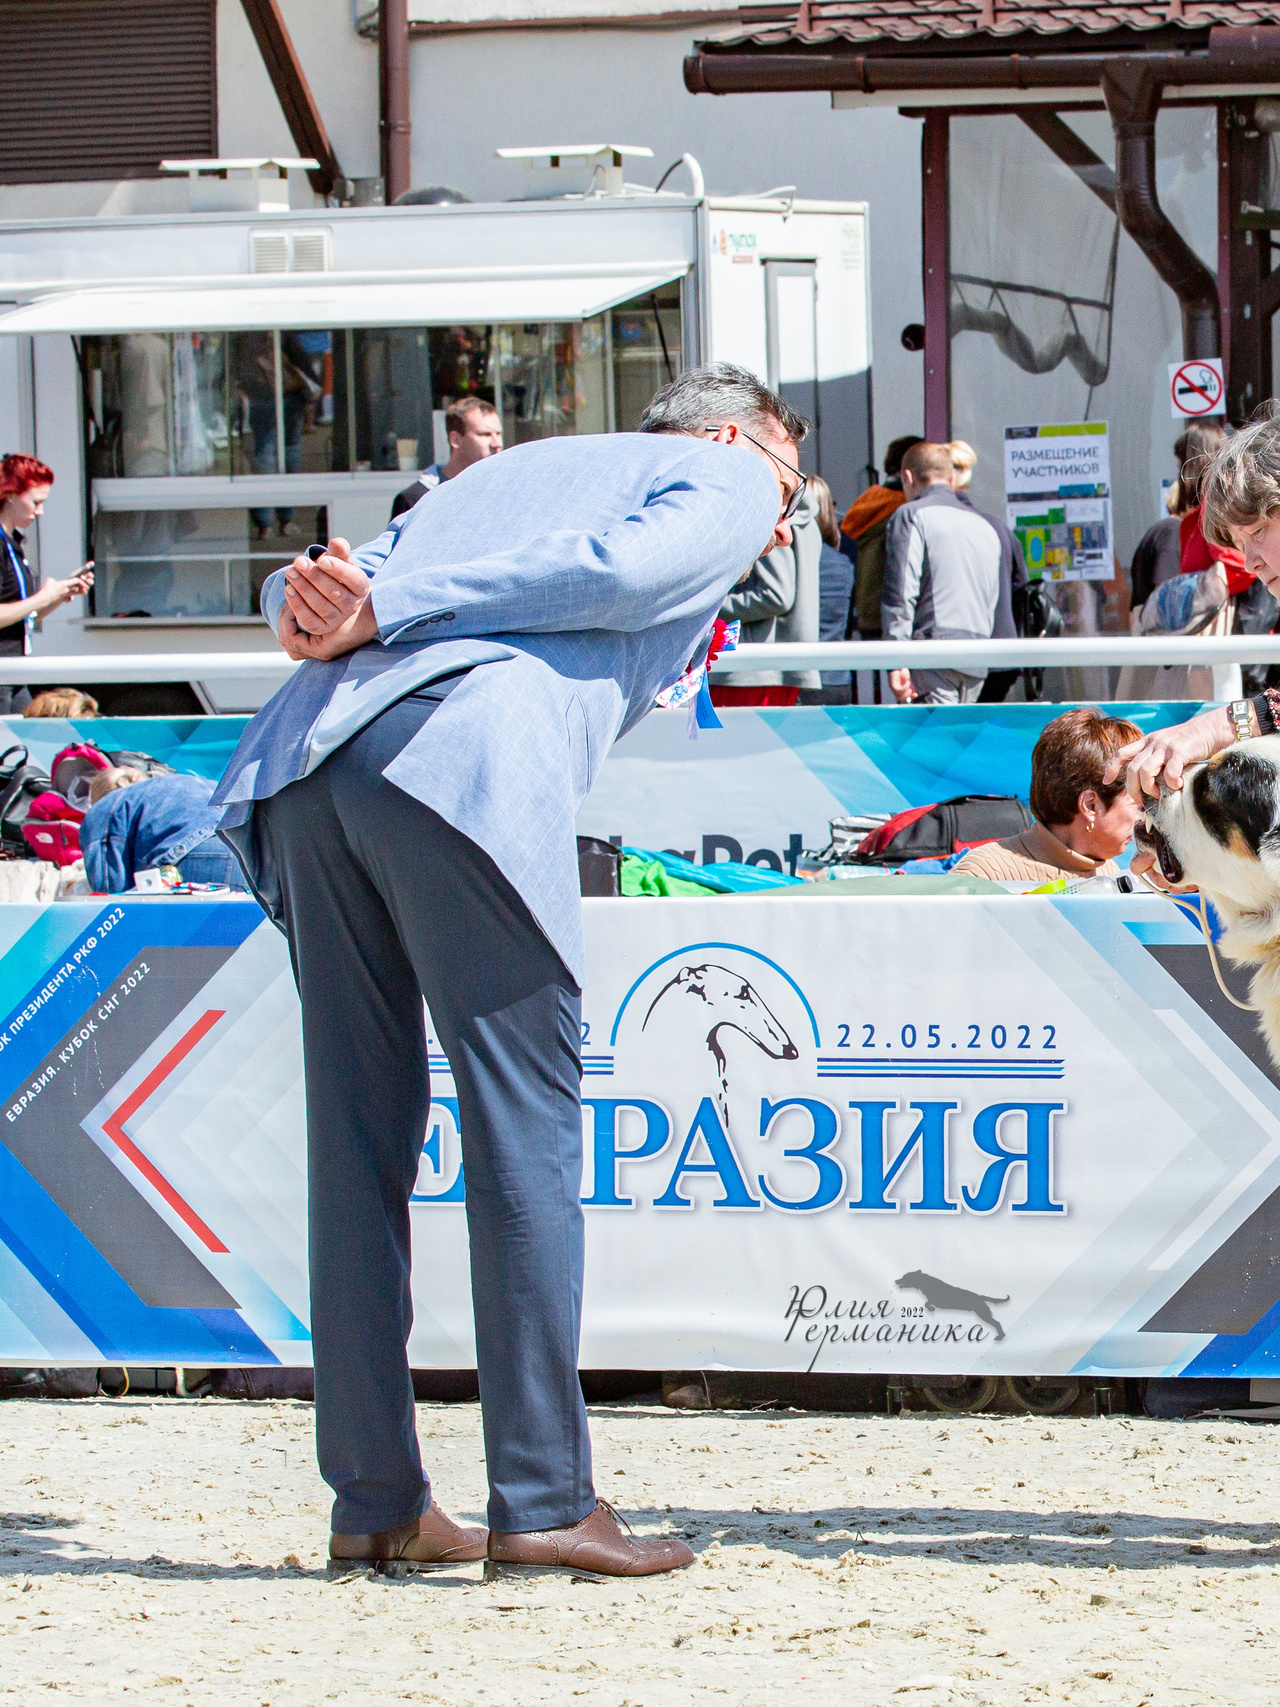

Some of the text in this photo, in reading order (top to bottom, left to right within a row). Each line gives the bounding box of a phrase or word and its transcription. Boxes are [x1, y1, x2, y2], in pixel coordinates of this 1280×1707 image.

[1011, 446, 1099, 461] РАЗМЕЩЕНИЕ
[1012, 463, 1100, 478] УЧАСТНИКОВ
[9, 962, 76, 1035] ПРЕЗИДЕНТА
[73, 935, 98, 964] РКФ
[97, 907, 126, 938] 2022
[5, 962, 151, 1123] ЕВРАЗИЯ. КУБОК СНГ 2022
[836, 1023, 1058, 1049] 22.05.2022
[410, 1096, 1065, 1212] ЕРАЗИЯ
